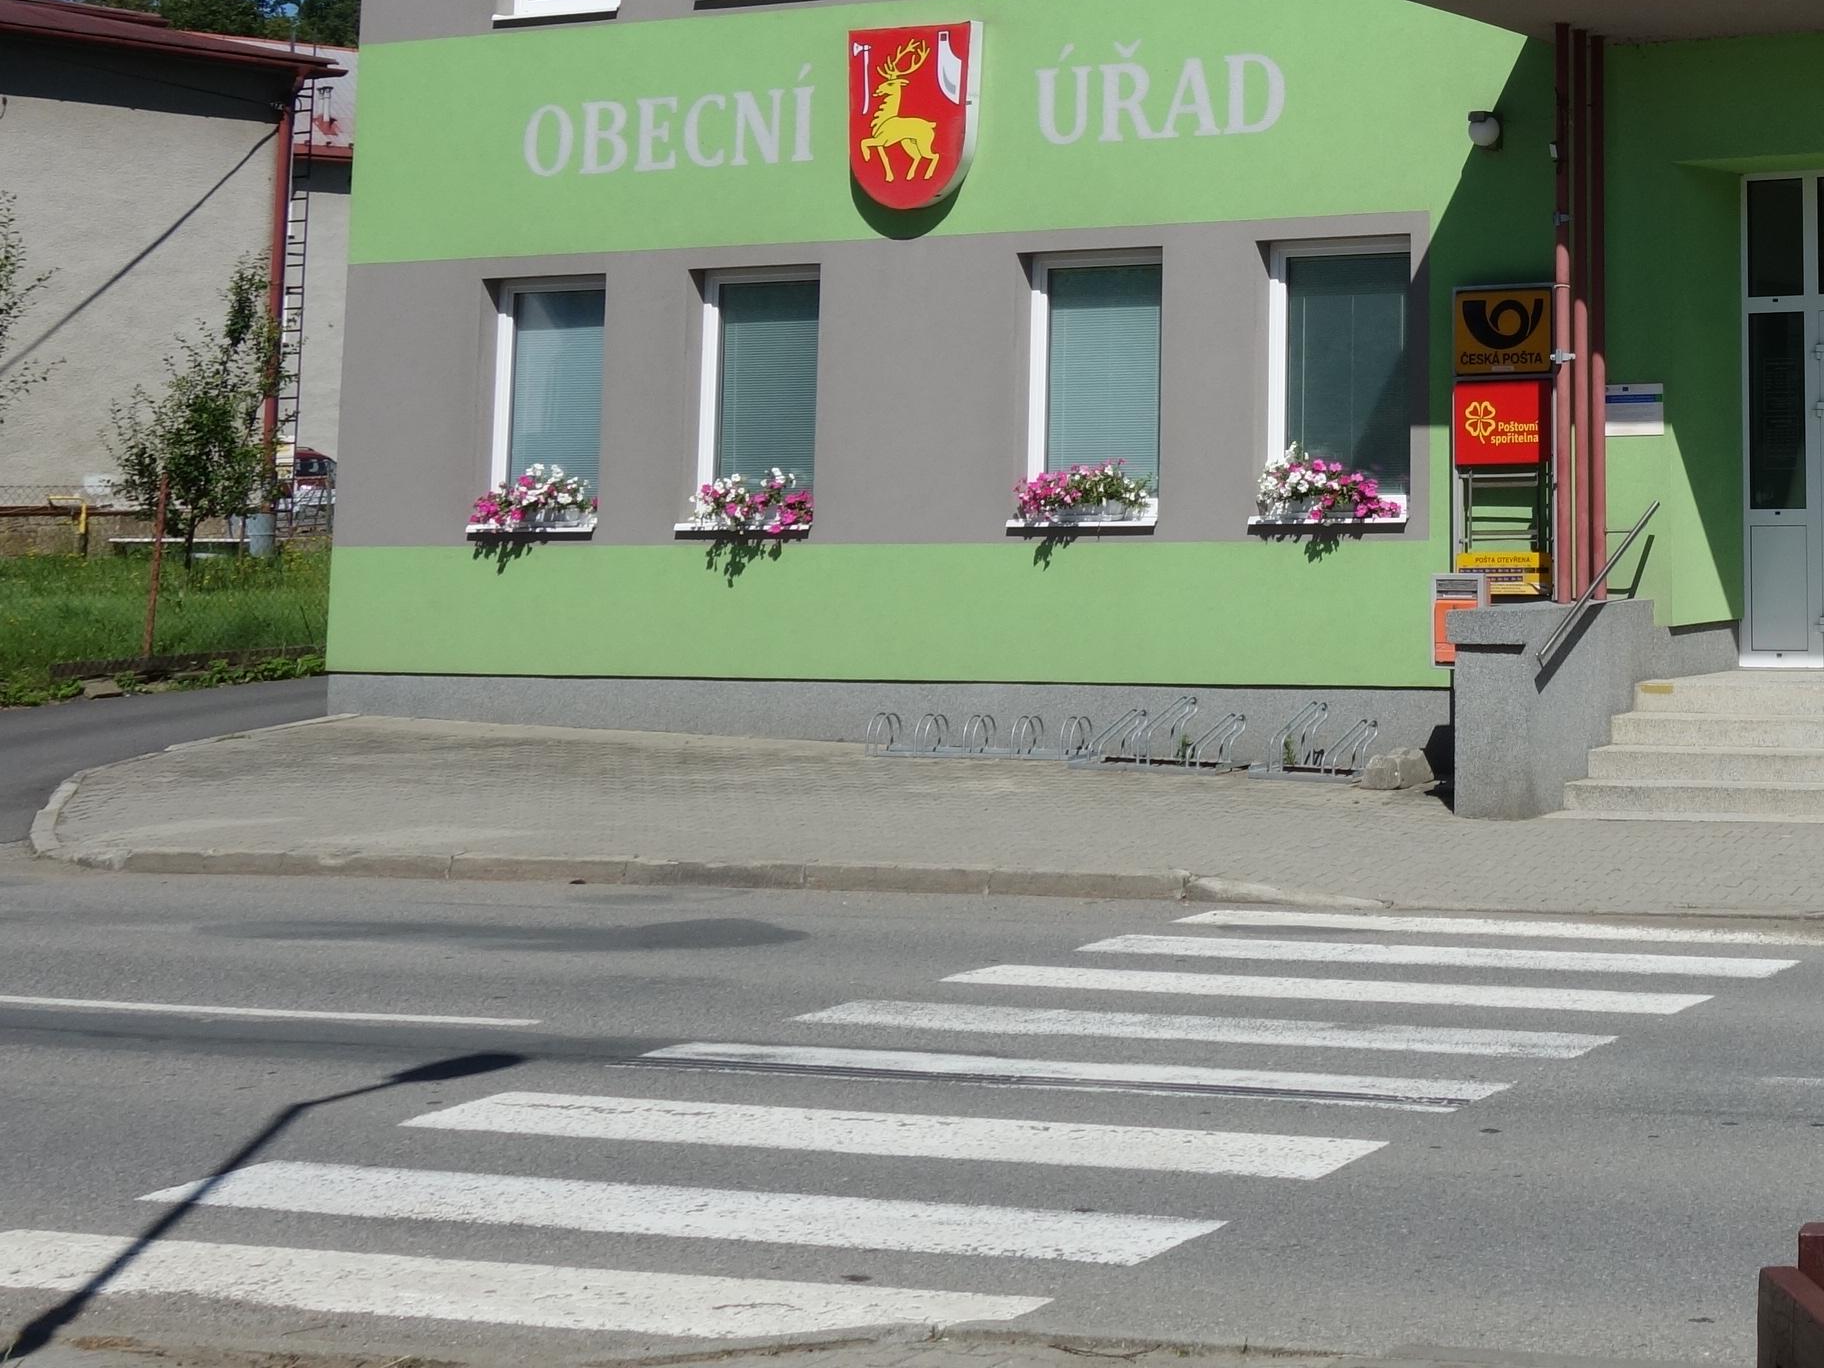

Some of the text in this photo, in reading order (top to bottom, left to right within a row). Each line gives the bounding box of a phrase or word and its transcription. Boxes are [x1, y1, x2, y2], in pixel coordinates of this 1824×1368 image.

[522, 40, 1286, 177] OBECNÍ ÚŘAD
[1460, 350, 1543, 365] ČESKÁ POŠTA
[1498, 420, 1539, 432] Poštovní
[1490, 432, 1539, 446] spořitelna
[1475, 555, 1531, 563] POŠTA OTEVŘENA
